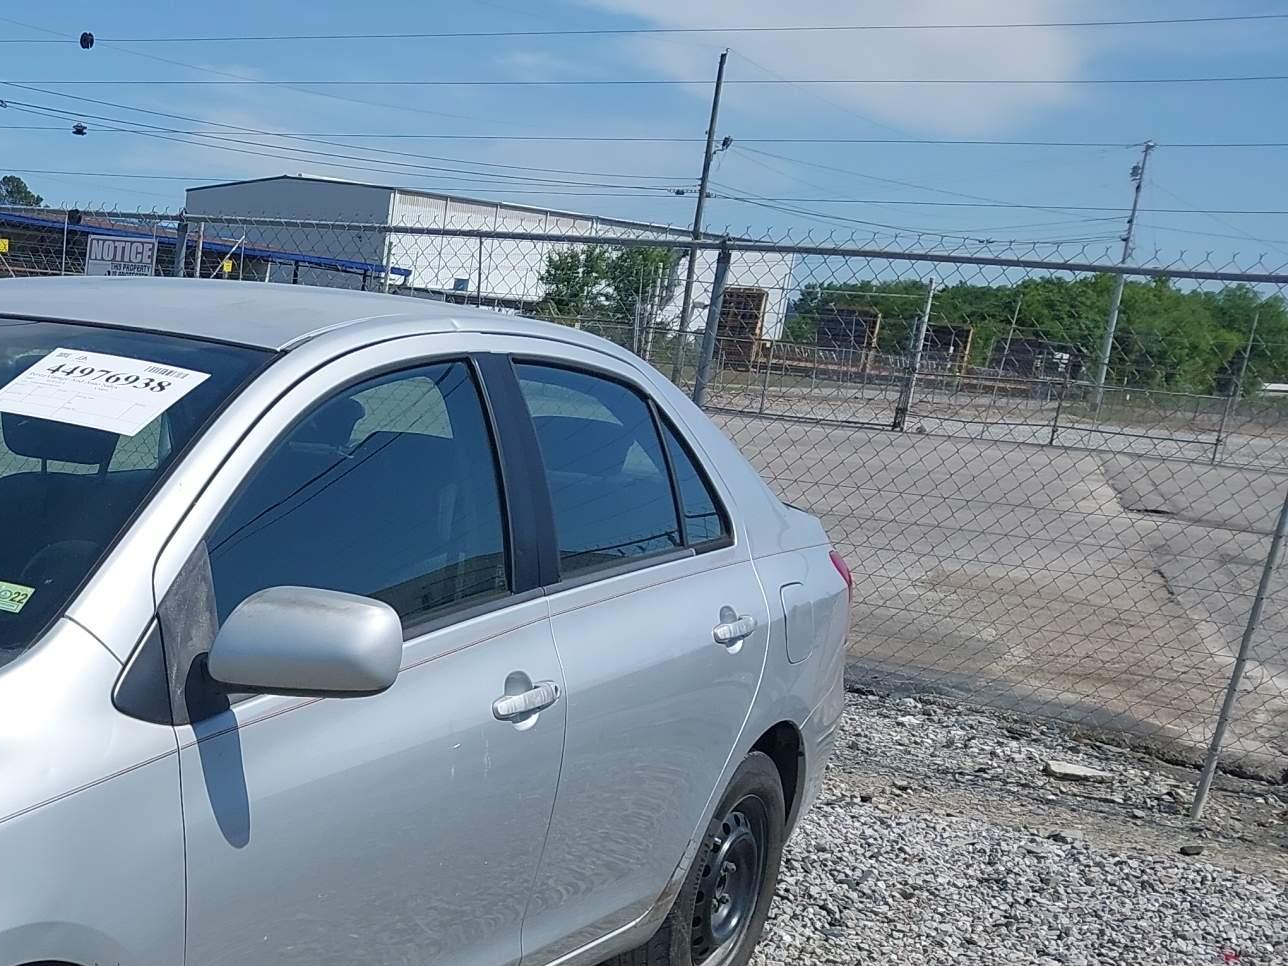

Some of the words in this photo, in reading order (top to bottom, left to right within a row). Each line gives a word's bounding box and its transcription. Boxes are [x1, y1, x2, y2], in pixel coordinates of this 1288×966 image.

[91, 240, 153, 263] NOTICE
[111, 263, 122, 271] THIS
[123, 263, 151, 272] PROPERTY
[47, 363, 172, 392] 44976938
[9, 591, 28, 604] 22
